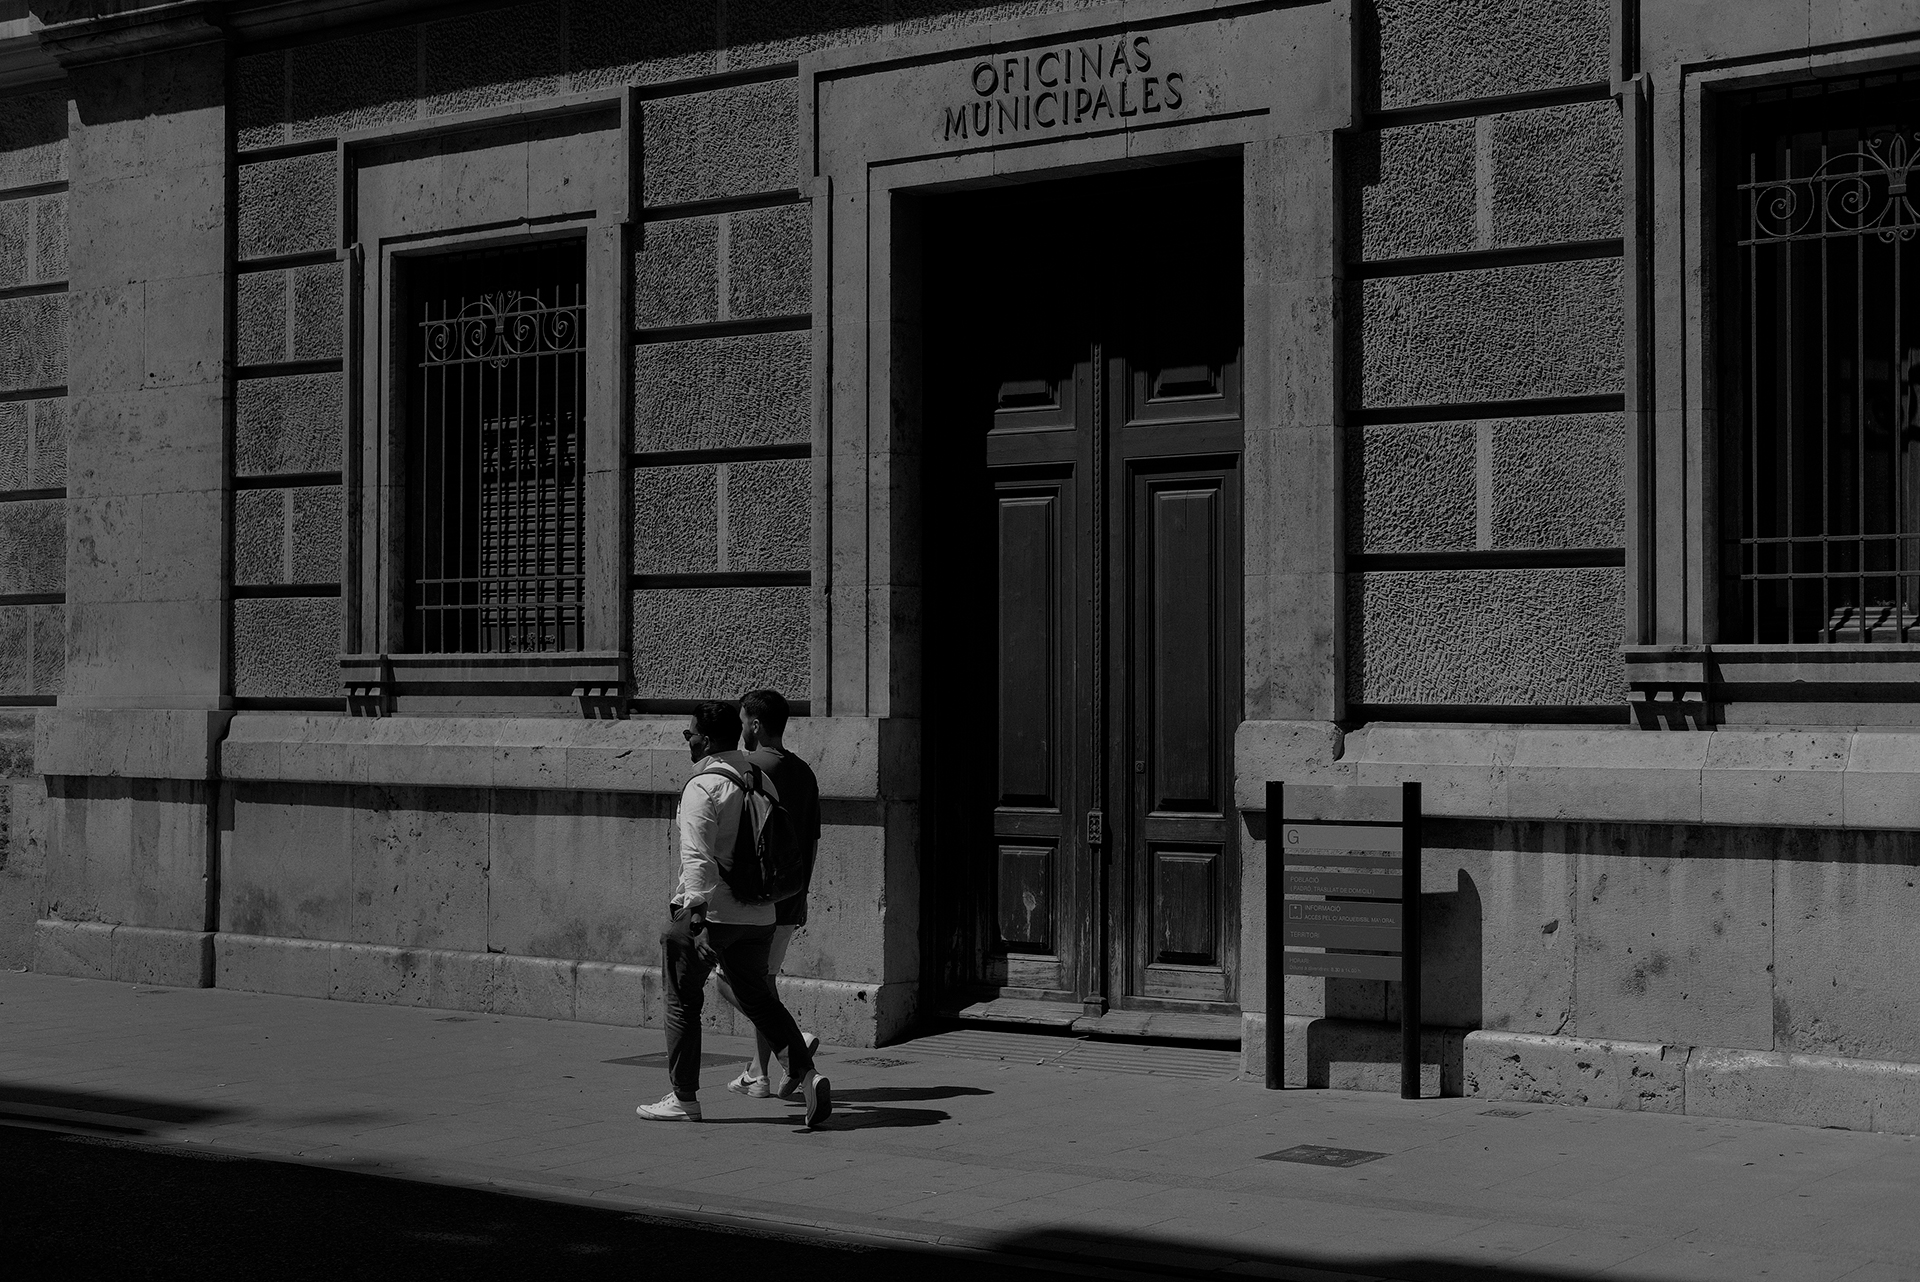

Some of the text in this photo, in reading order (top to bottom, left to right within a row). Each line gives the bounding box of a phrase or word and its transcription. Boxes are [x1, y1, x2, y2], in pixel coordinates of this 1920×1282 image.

[971, 36, 1152, 97] OFICINAS
[944, 72, 1184, 141] MUNICIPALES
[1287, 829, 1299, 845] G
[1305, 904, 1341, 912] INFORMACIÓ
